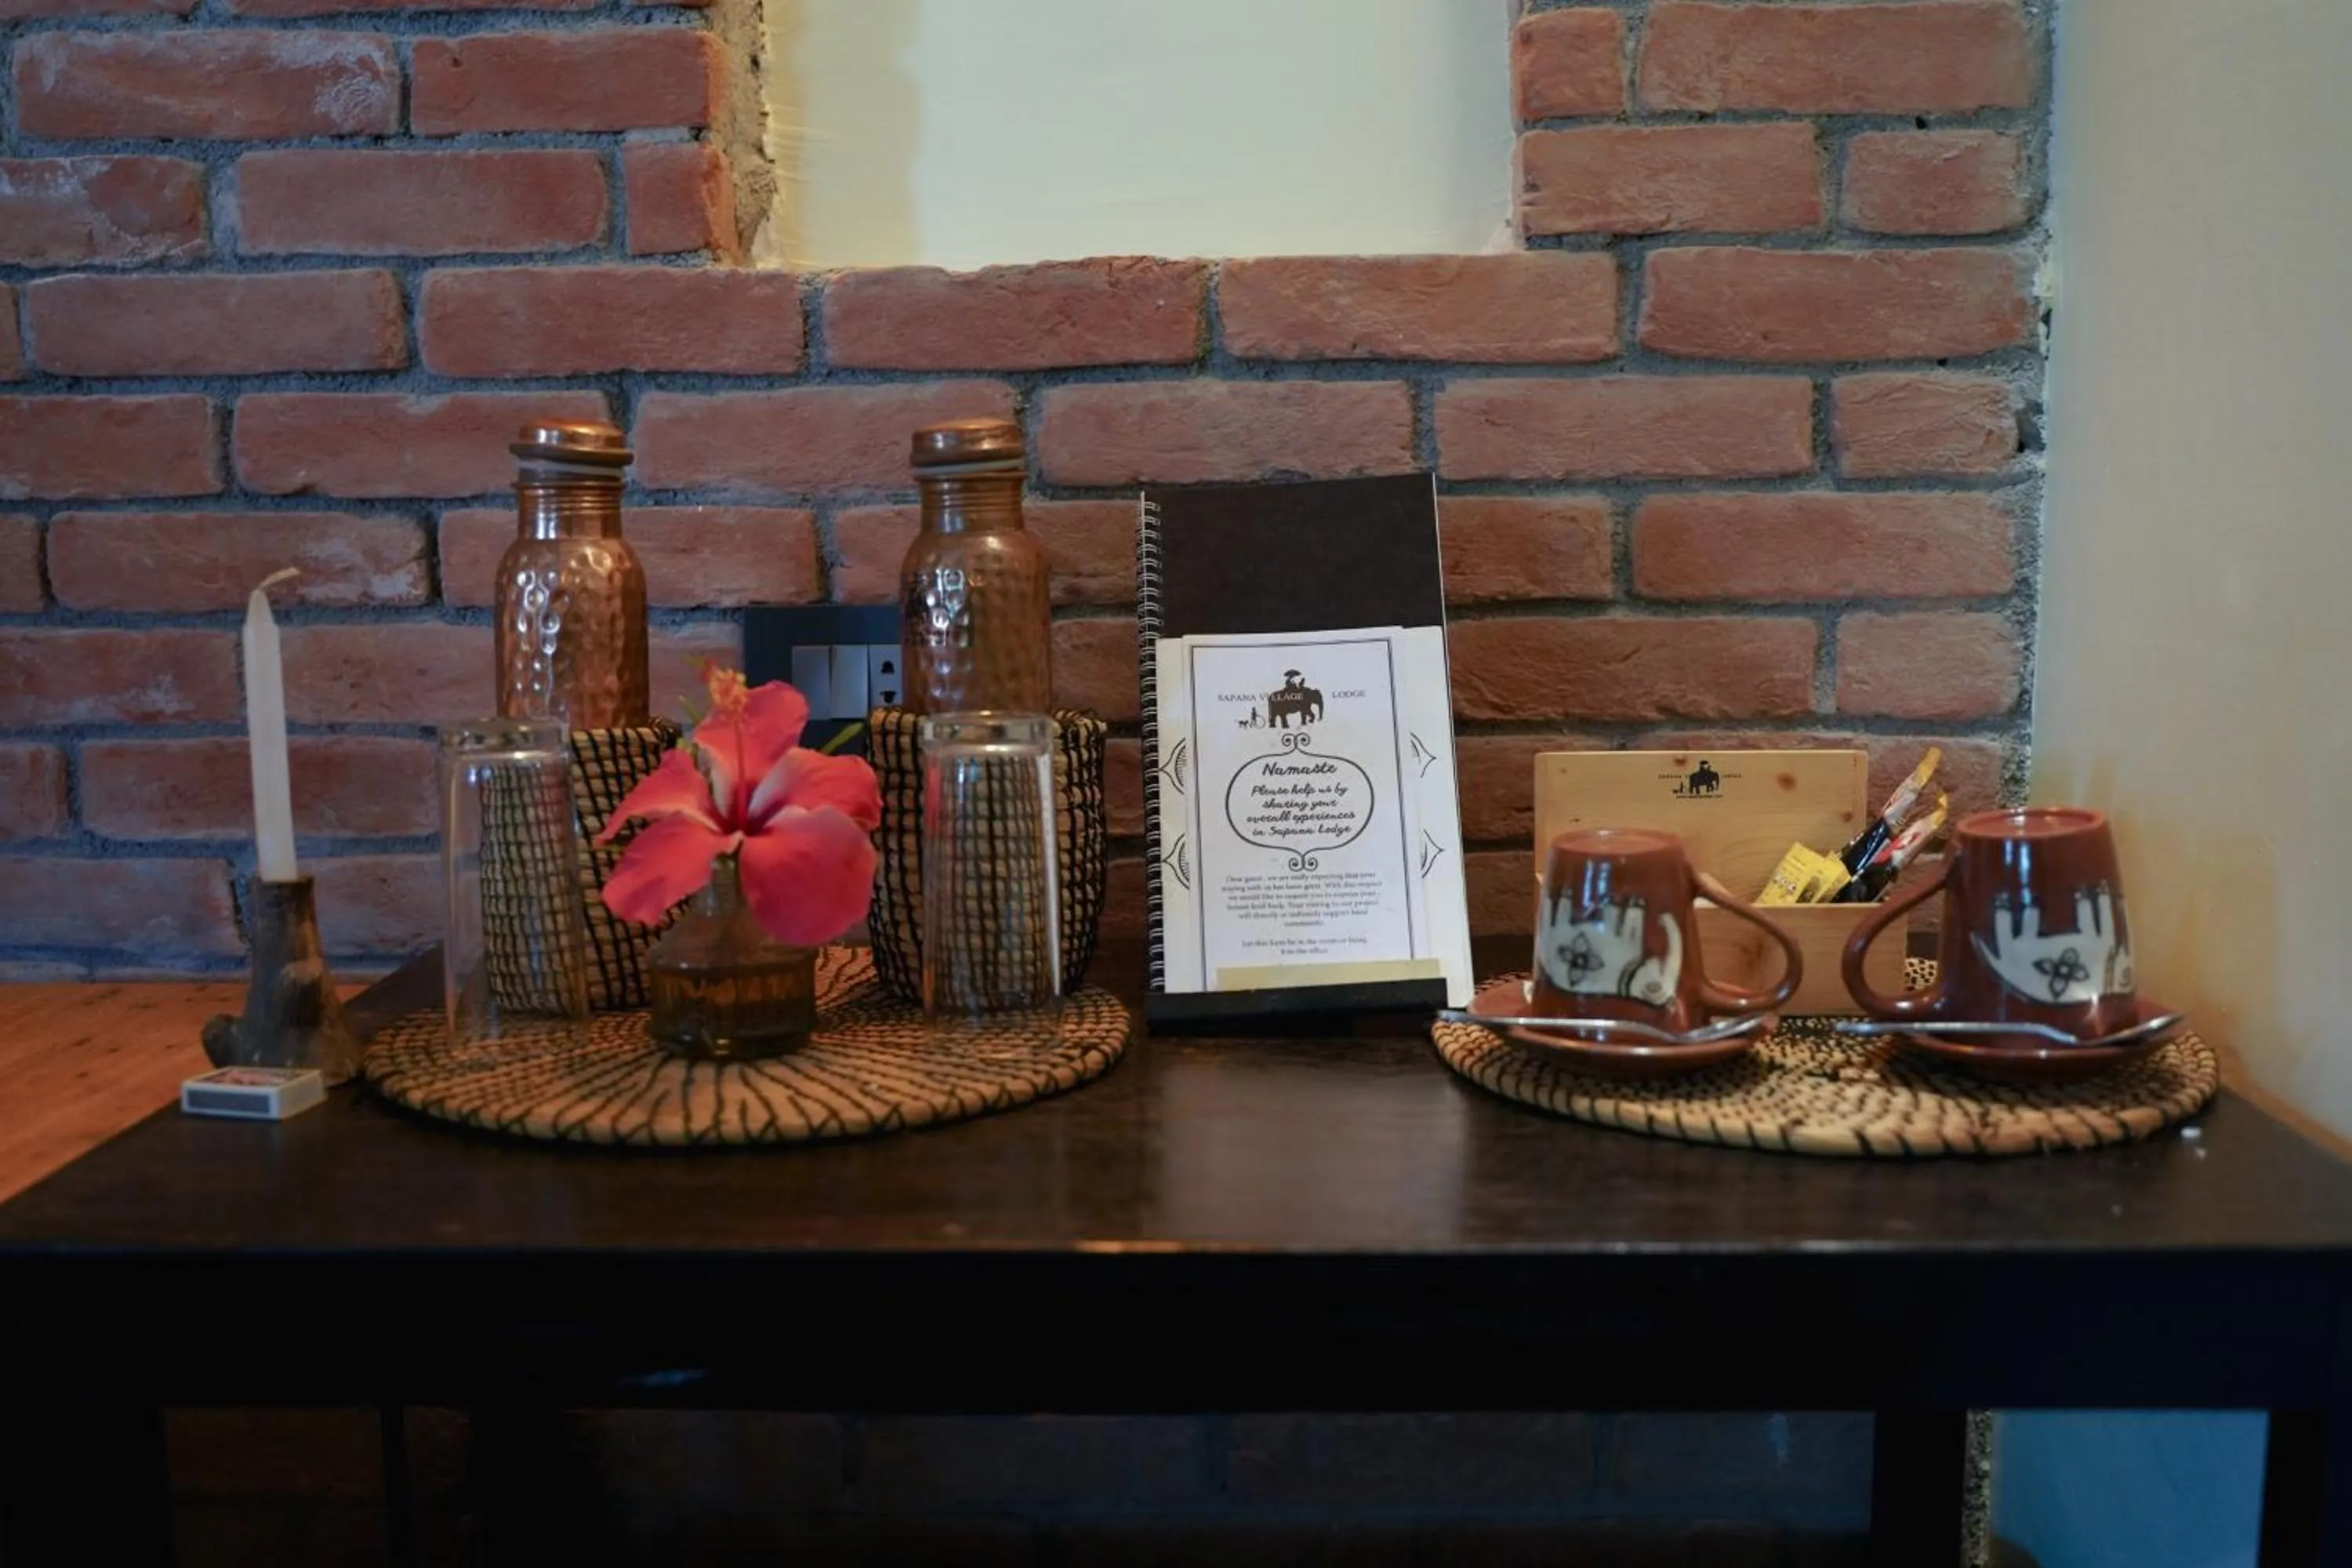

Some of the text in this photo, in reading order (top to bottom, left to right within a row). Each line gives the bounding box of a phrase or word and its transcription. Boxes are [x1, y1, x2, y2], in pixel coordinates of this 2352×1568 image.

[1217, 689, 1366, 702] SAPANA VILLAGE LODGE
[1262, 761, 1338, 776] Namaste
[1250, 782, 1348, 797] Please help us by
[1262, 798, 1338, 811] sharing your
[1247, 810, 1290, 823] overall
[1252, 824, 1352, 838] in Sapana Lodge
